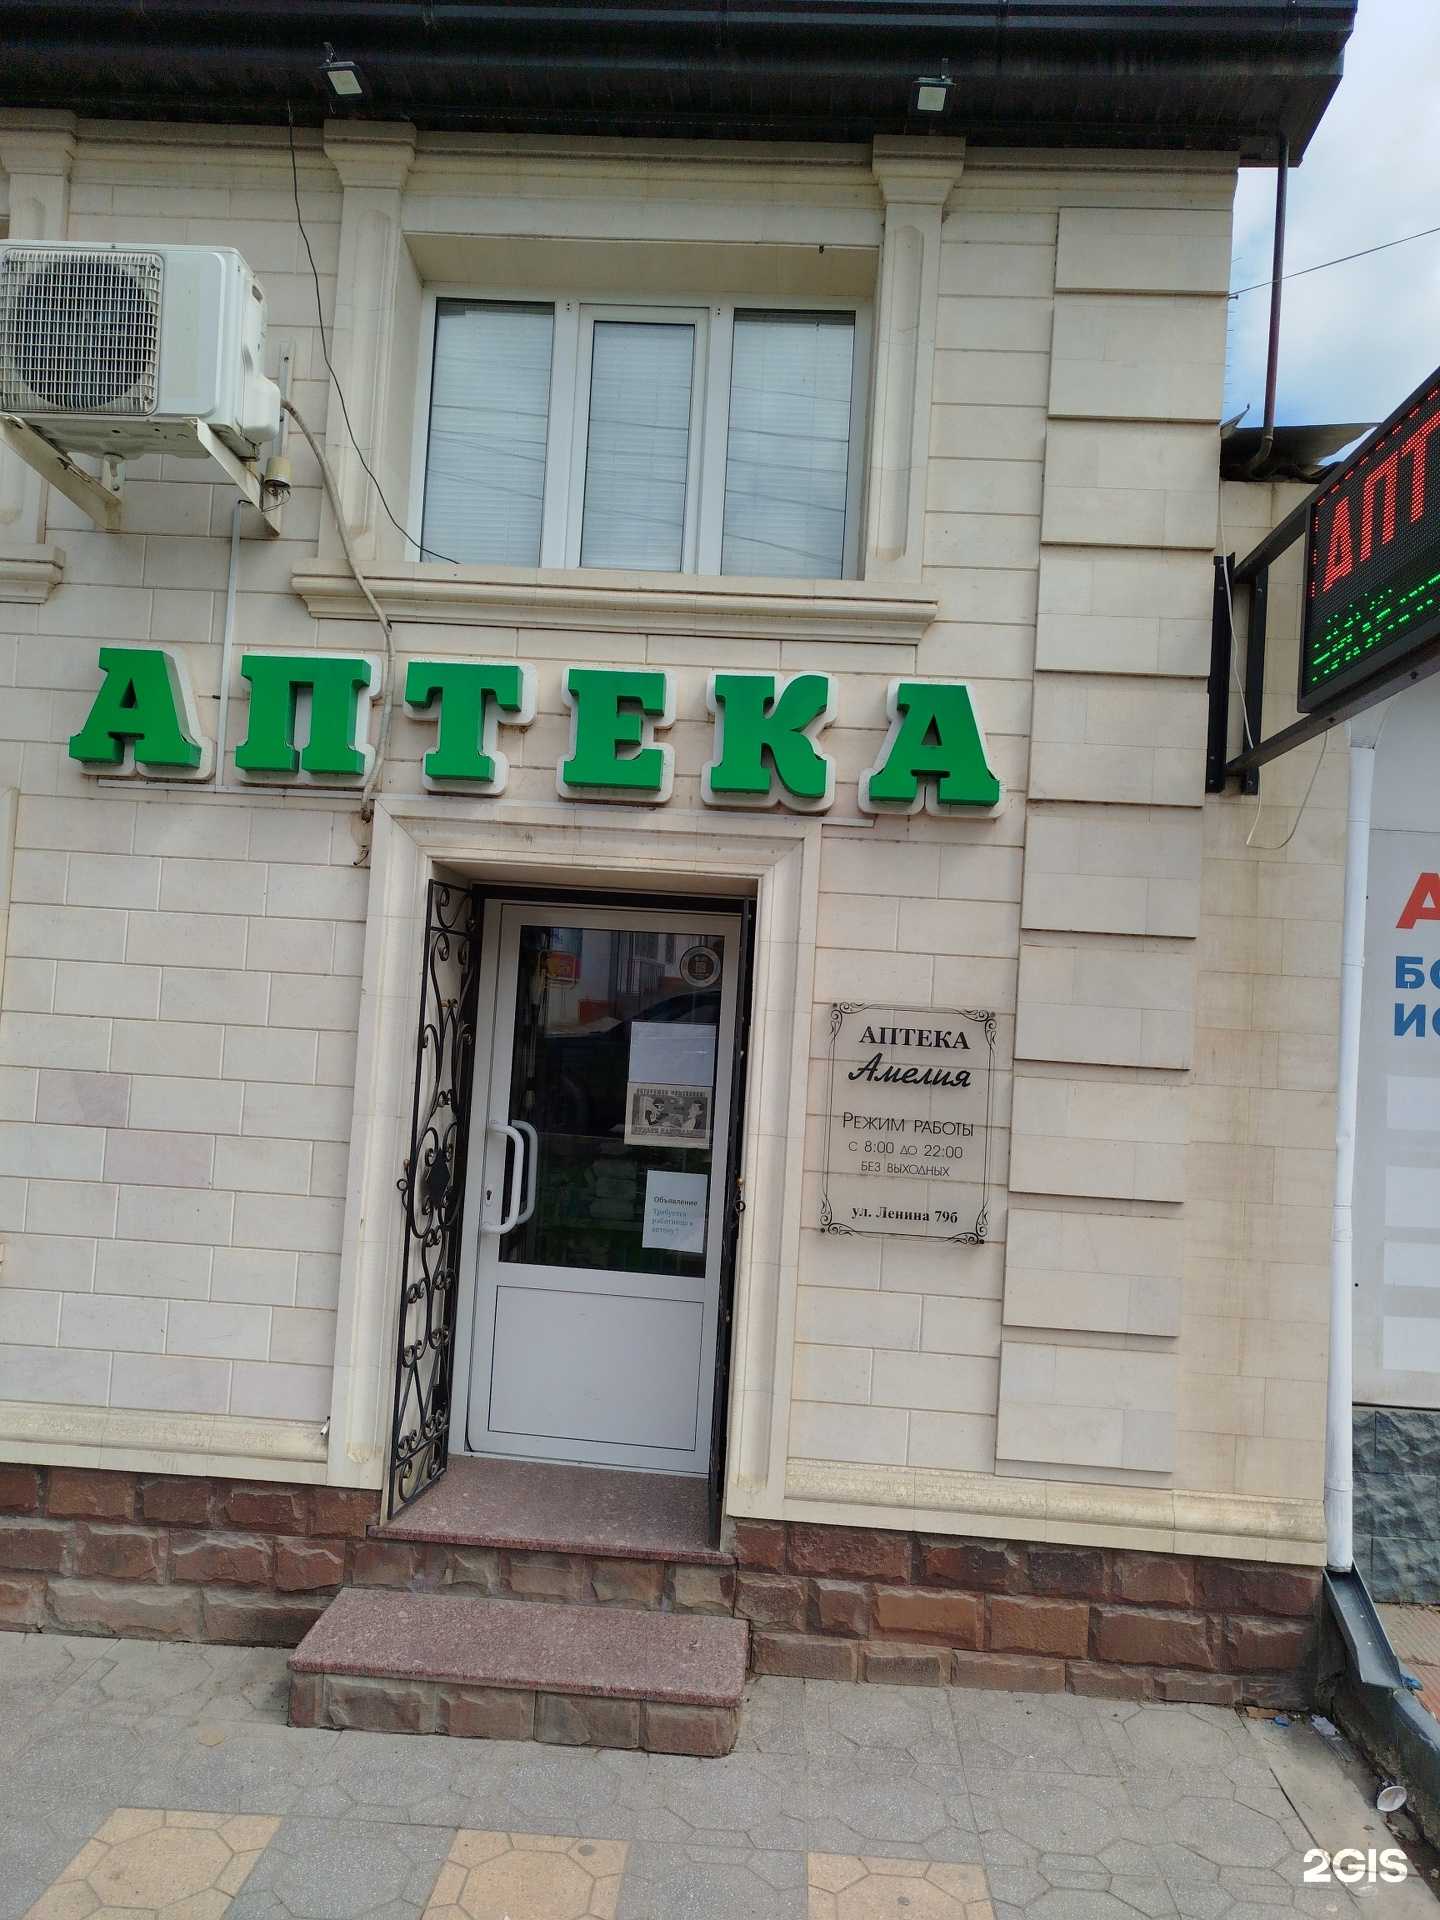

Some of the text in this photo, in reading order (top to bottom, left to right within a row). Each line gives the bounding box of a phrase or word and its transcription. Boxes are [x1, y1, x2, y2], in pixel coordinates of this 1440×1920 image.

[69, 646, 1001, 808] АПТЕКА
[1394, 1002, 1440, 1038] И
[859, 1025, 972, 1050] АПТЕКА
[848, 1052, 972, 1088] Амелия
[914, 1119, 974, 1137] РАБОТЫ
[864, 1140, 895, 1154] 8:00
[924, 1144, 963, 1159] 22:00
[861, 1160, 950, 1177] БЕЗ ВЫХОДНЫХ
[851, 1207, 872, 1219] ул.
[876, 1206, 930, 1222] Ленина
